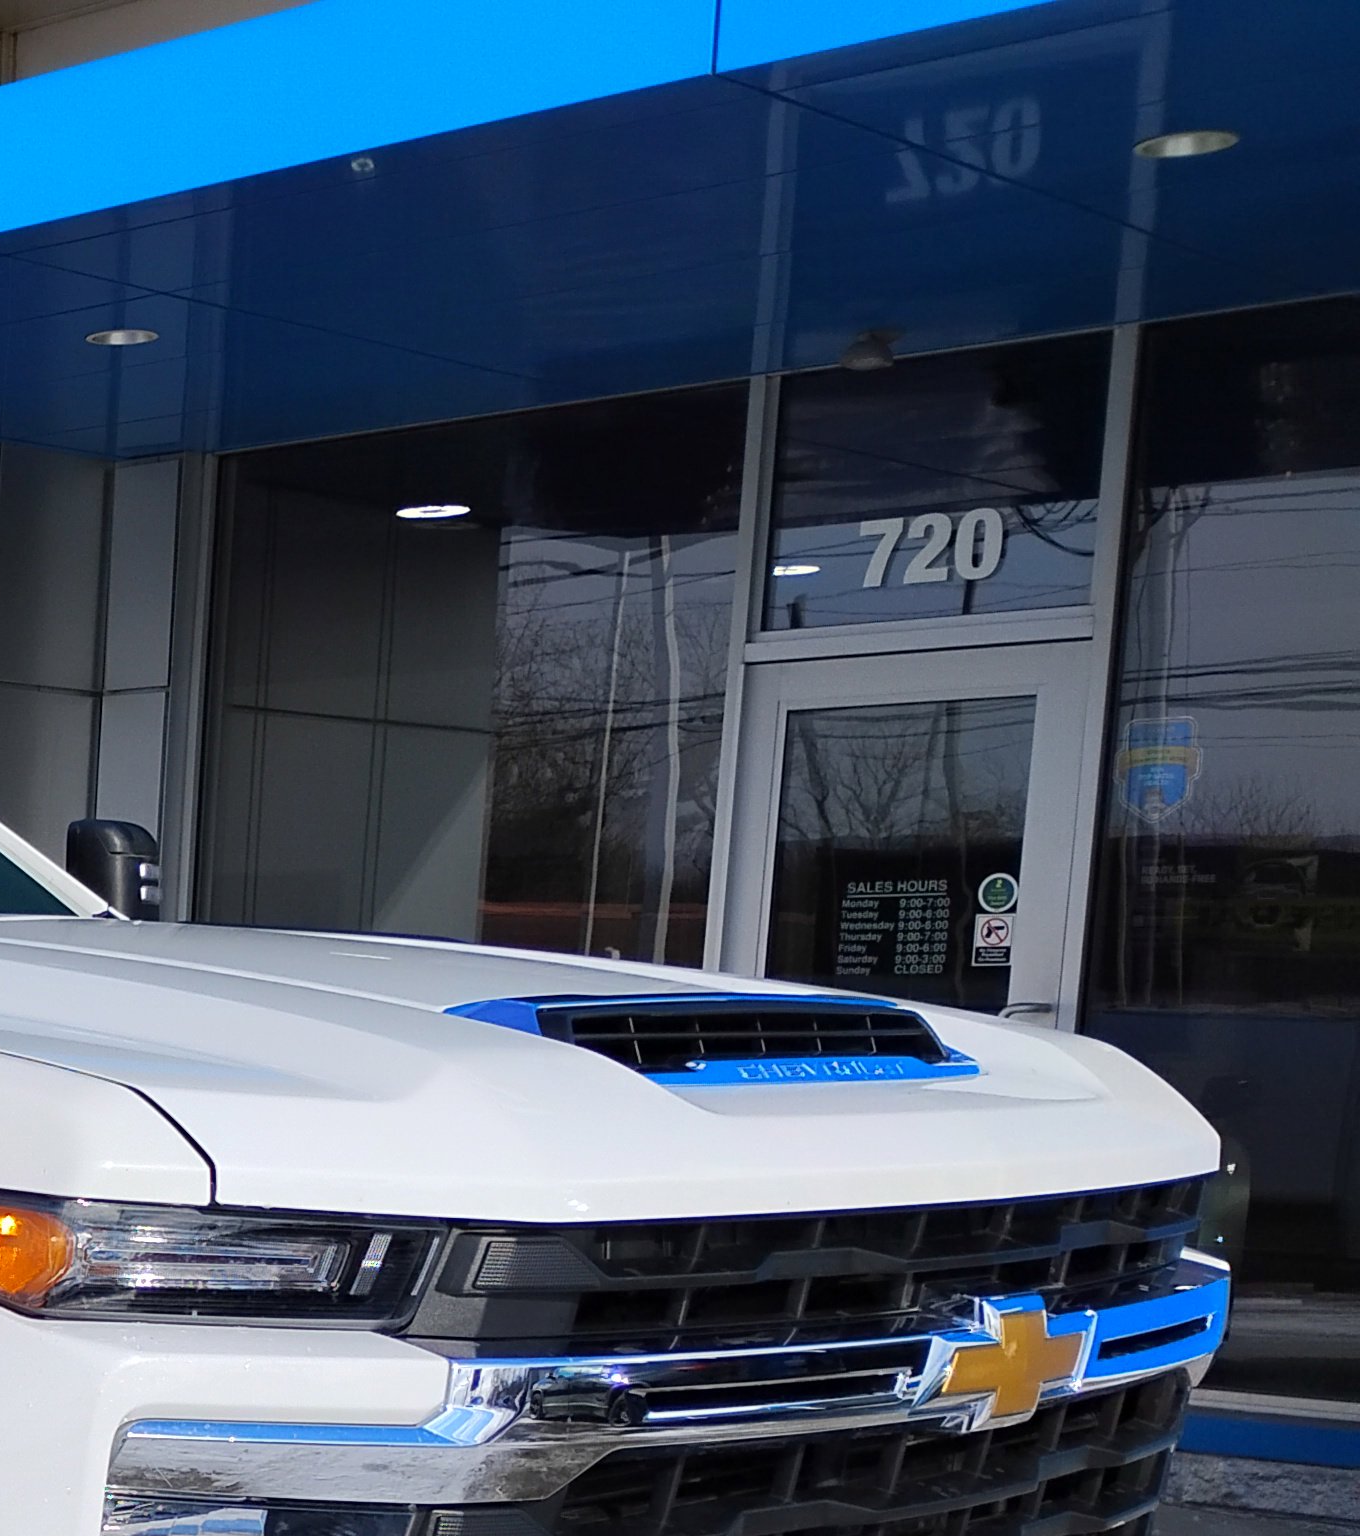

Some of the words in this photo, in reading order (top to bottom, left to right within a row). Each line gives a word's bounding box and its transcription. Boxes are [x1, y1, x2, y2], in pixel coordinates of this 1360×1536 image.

[860, 507, 1003, 588] 720
[847, 881, 893, 894] SALES
[897, 880, 948, 892] HOURS
[842, 900, 880, 909] Monday
[841, 911, 879, 920] Tuesday
[840, 921, 895, 931] Wednesday
[840, 932, 882, 942] Thursday
[838, 944, 867, 954] Friday
[837, 955, 879, 965] Saturday
[836, 966, 871, 976] Sunday
[894, 964, 944, 974] CLOSED
